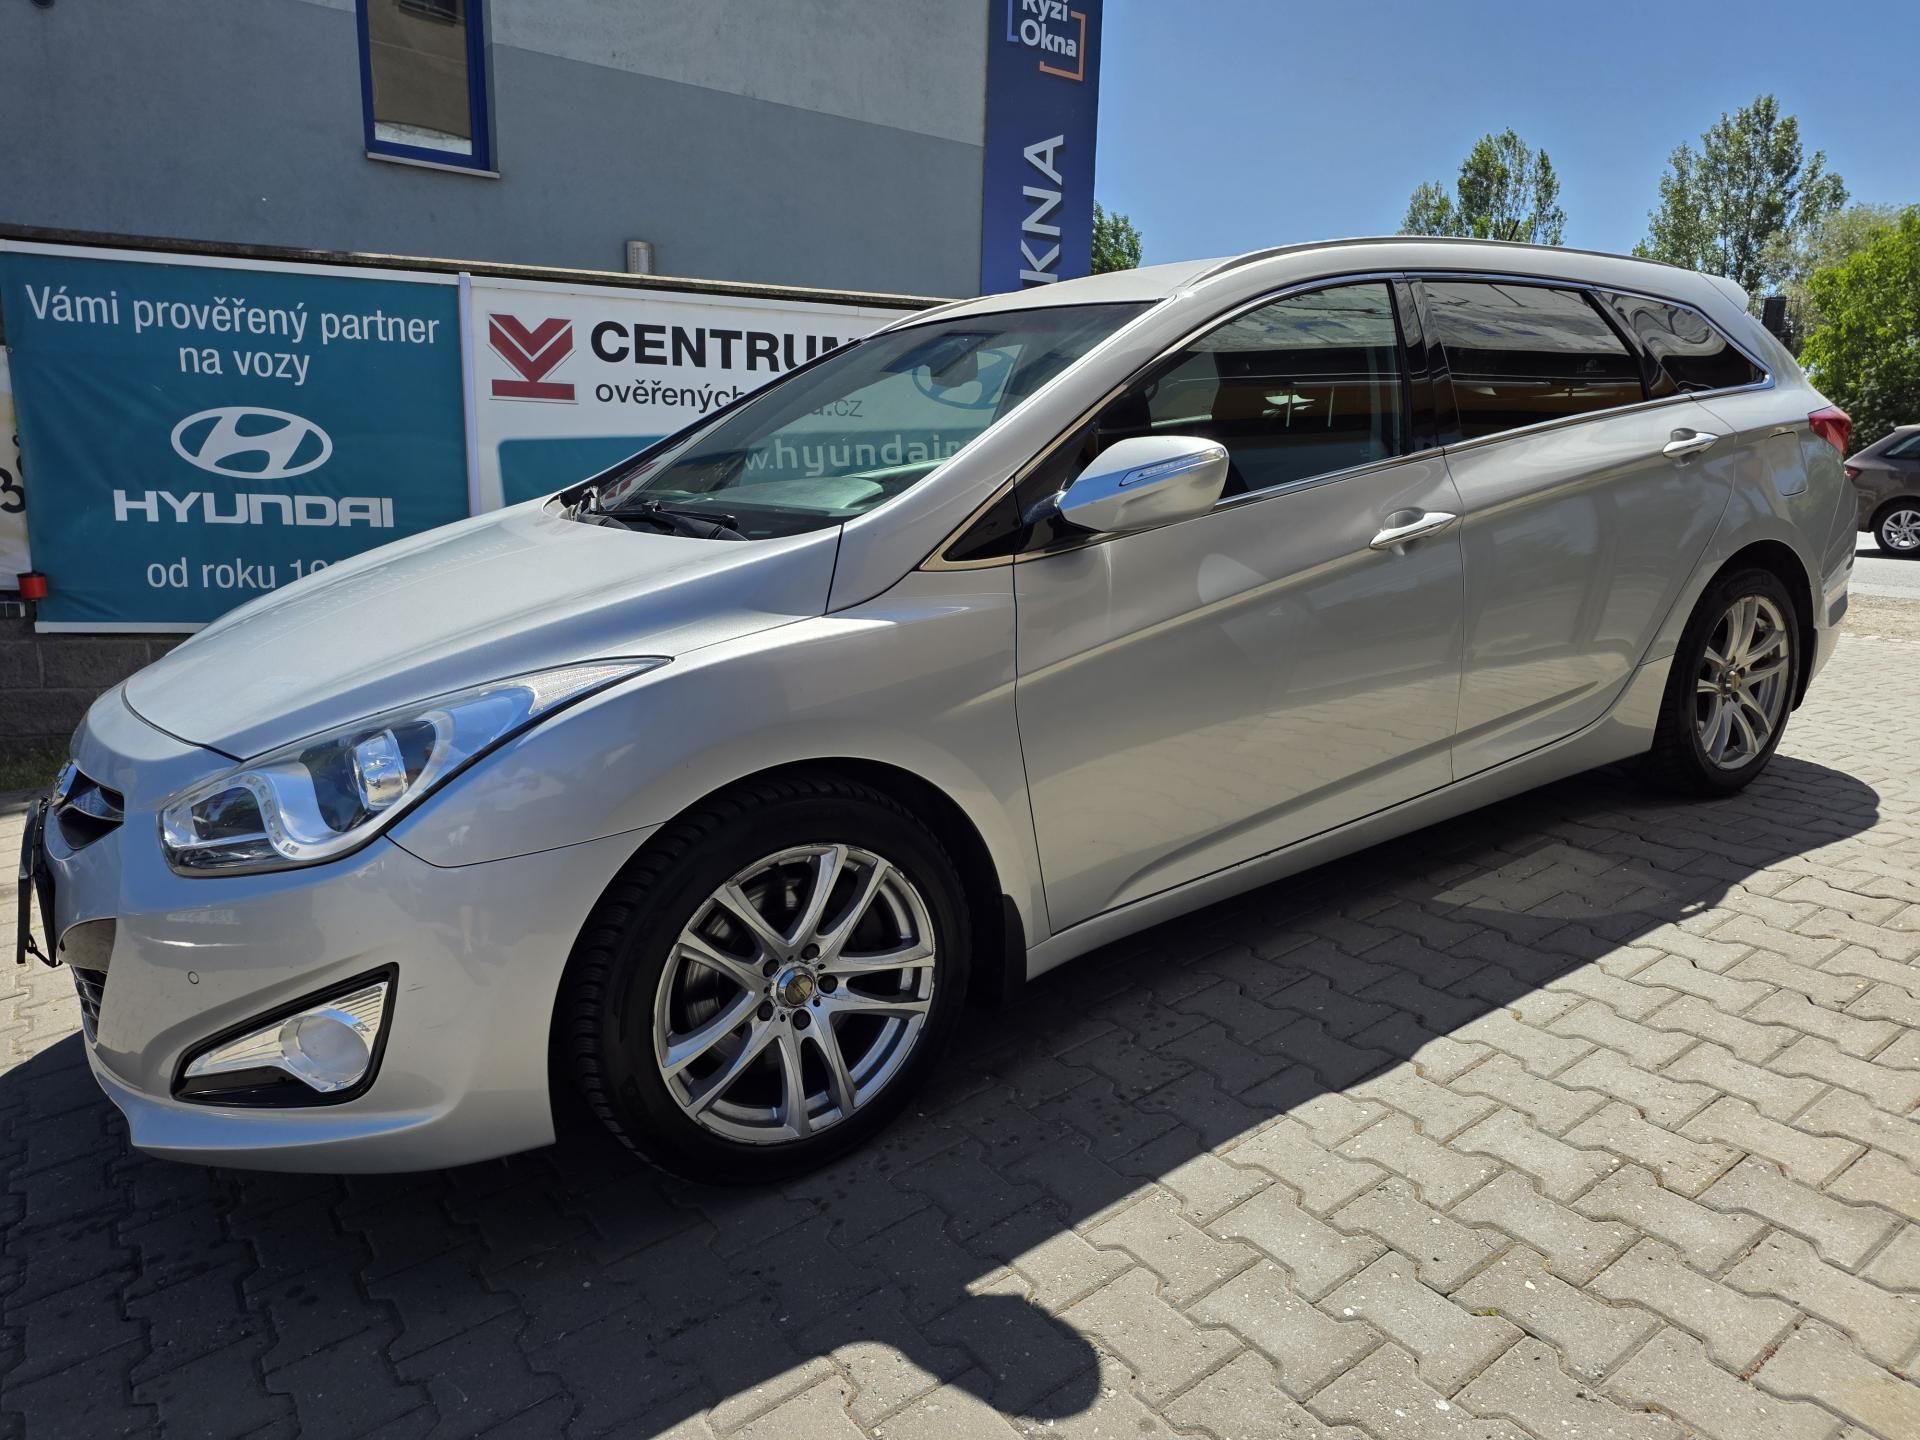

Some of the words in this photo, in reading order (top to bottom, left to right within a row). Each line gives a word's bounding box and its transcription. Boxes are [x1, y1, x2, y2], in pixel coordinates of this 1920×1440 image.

[1020, 19, 1077, 57] Okna
[25, 284, 119, 325] Vámi
[134, 297, 307, 343] prověřený
[321, 309, 440, 344] partner
[179, 346, 223, 375] na
[233, 349, 311, 386] vozy
[113, 489, 395, 528] HYUNDAI
[147, 557, 189, 588] od
[202, 558, 277, 589] roku
